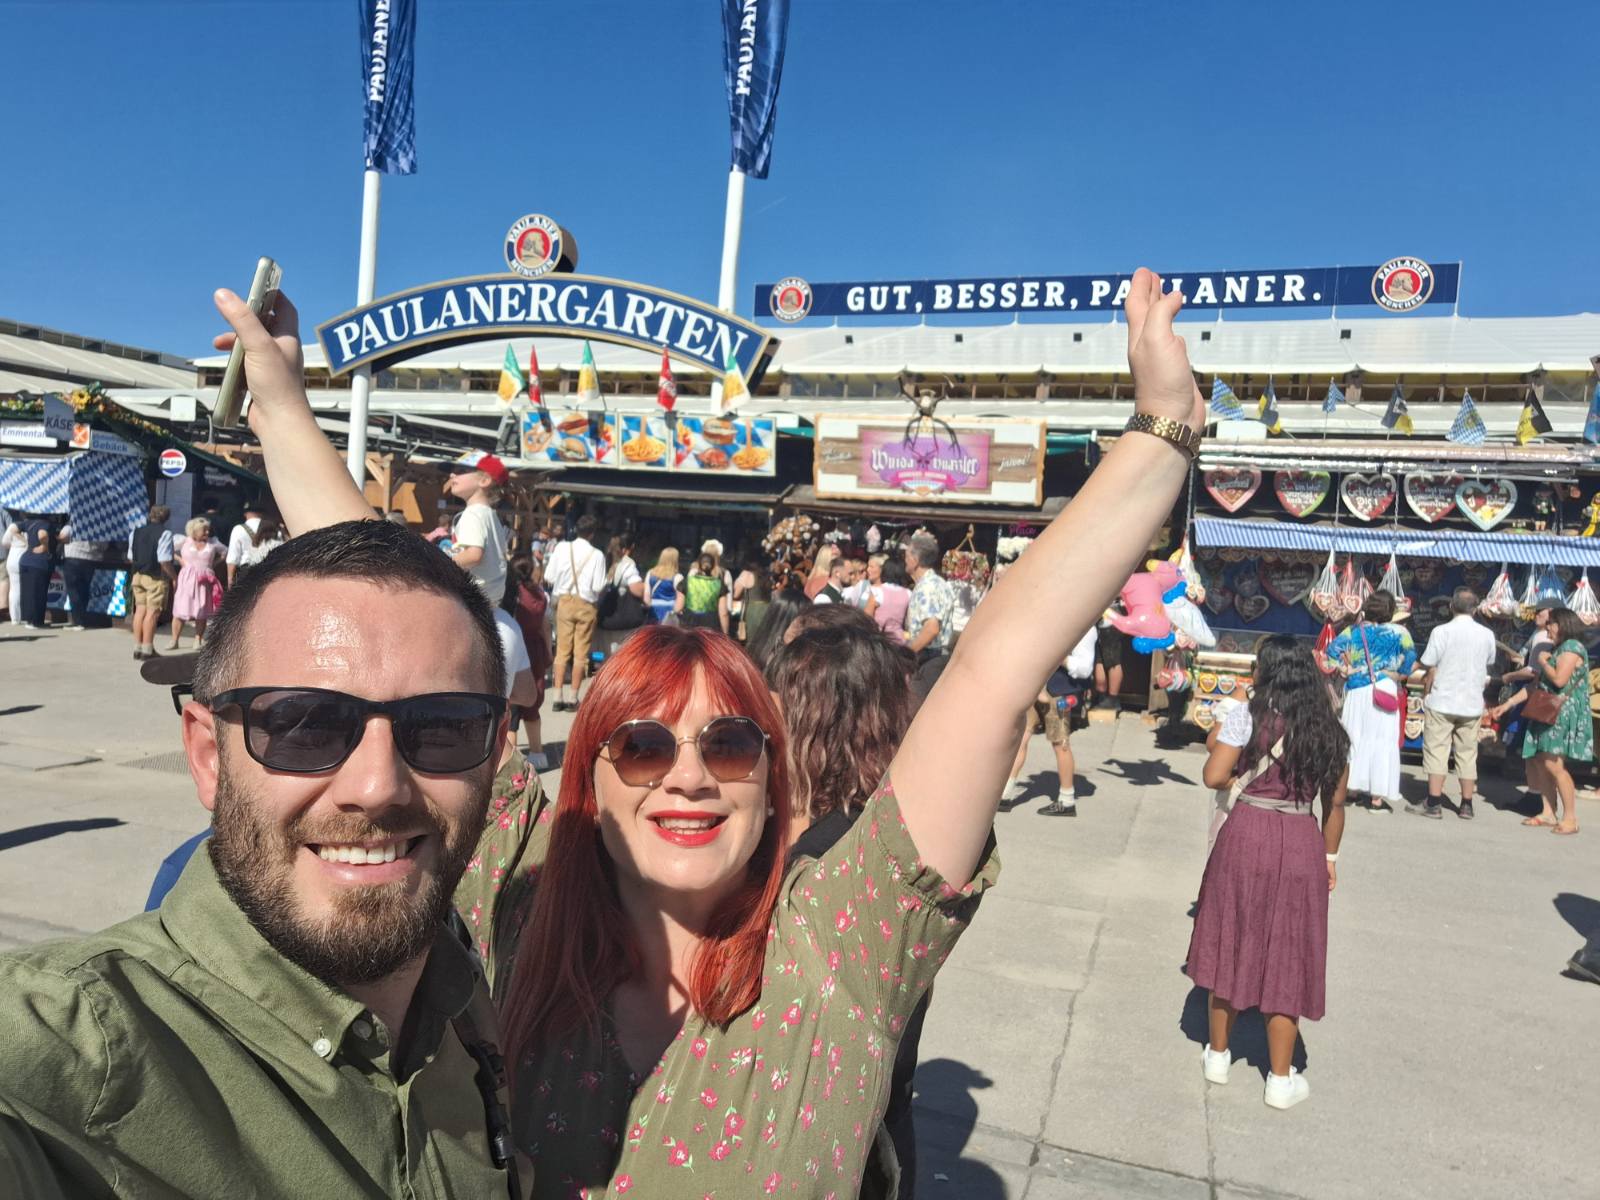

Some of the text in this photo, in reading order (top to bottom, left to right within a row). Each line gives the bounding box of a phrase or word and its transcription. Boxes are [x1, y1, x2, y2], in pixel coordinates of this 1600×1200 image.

[507, 215, 560, 243] PAULANER
[1378, 259, 1429, 280] PAULANER
[846, 275, 1322, 312] GUT, BESSER, PALANER.
[333, 283, 749, 367] PAULANERGARTEN
[46, 414, 74, 431] KÄSE
